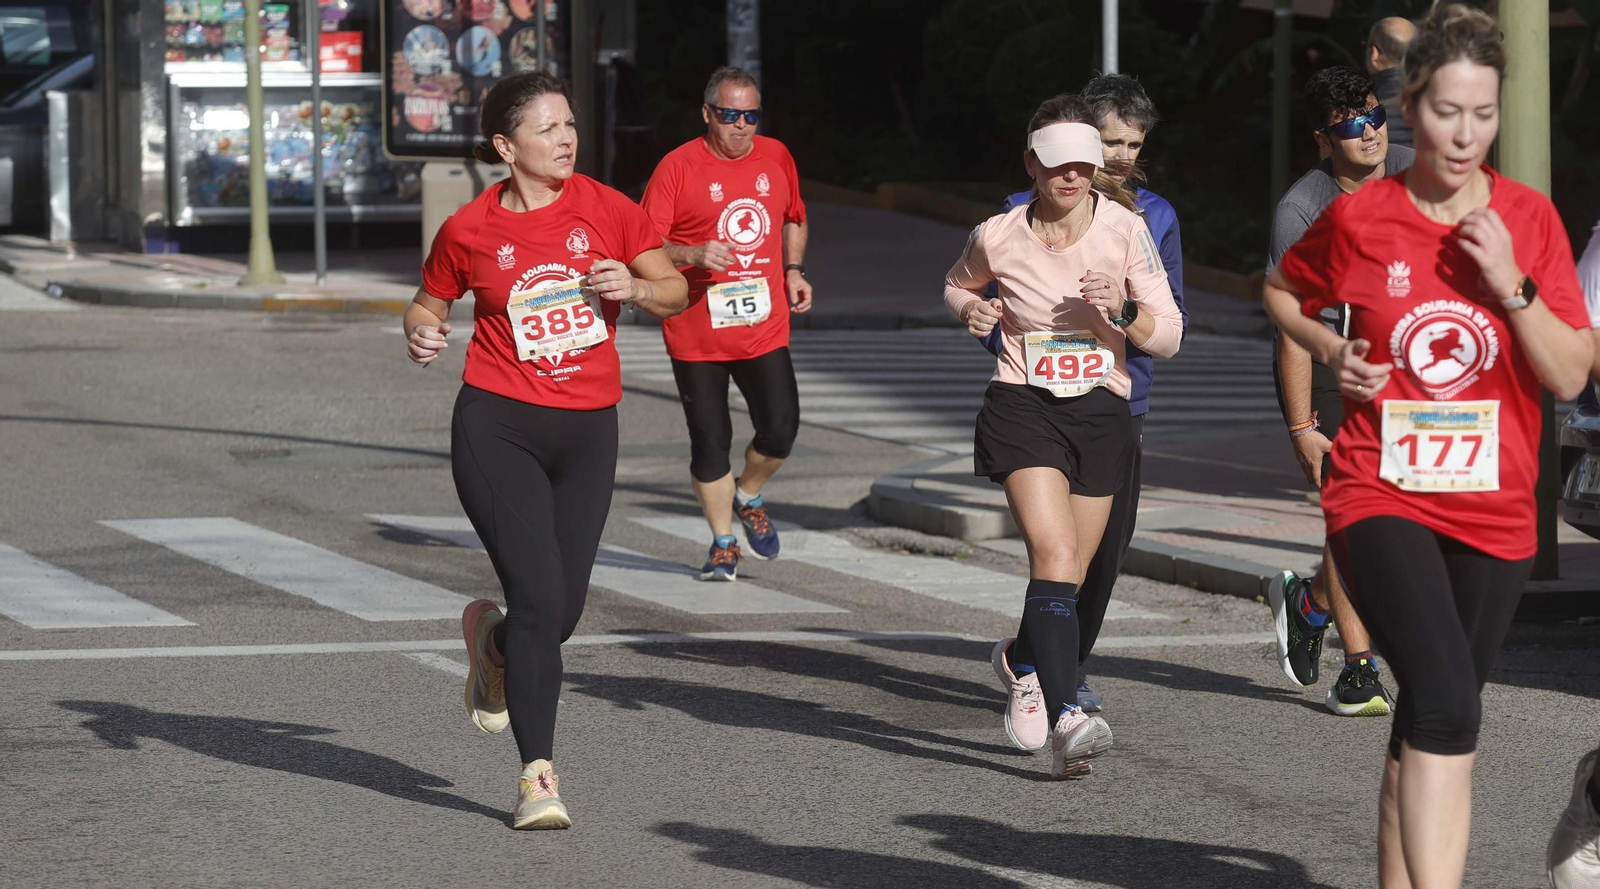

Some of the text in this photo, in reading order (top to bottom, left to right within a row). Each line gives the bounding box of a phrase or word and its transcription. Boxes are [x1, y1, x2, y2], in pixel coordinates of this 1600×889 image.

[498, 255, 516, 263] UCA
[522, 263, 566, 281] SOLIDARIA
[568, 270, 582, 280] DE
[725, 297, 757, 316] 15
[1413, 299, 1474, 318] SOLIDARIA
[1472, 311, 1490, 328] DE
[521, 302, 595, 341] 385
[537, 365, 582, 376] CUPRA
[1034, 353, 1103, 380] 492
[1397, 433, 1483, 467] 177
